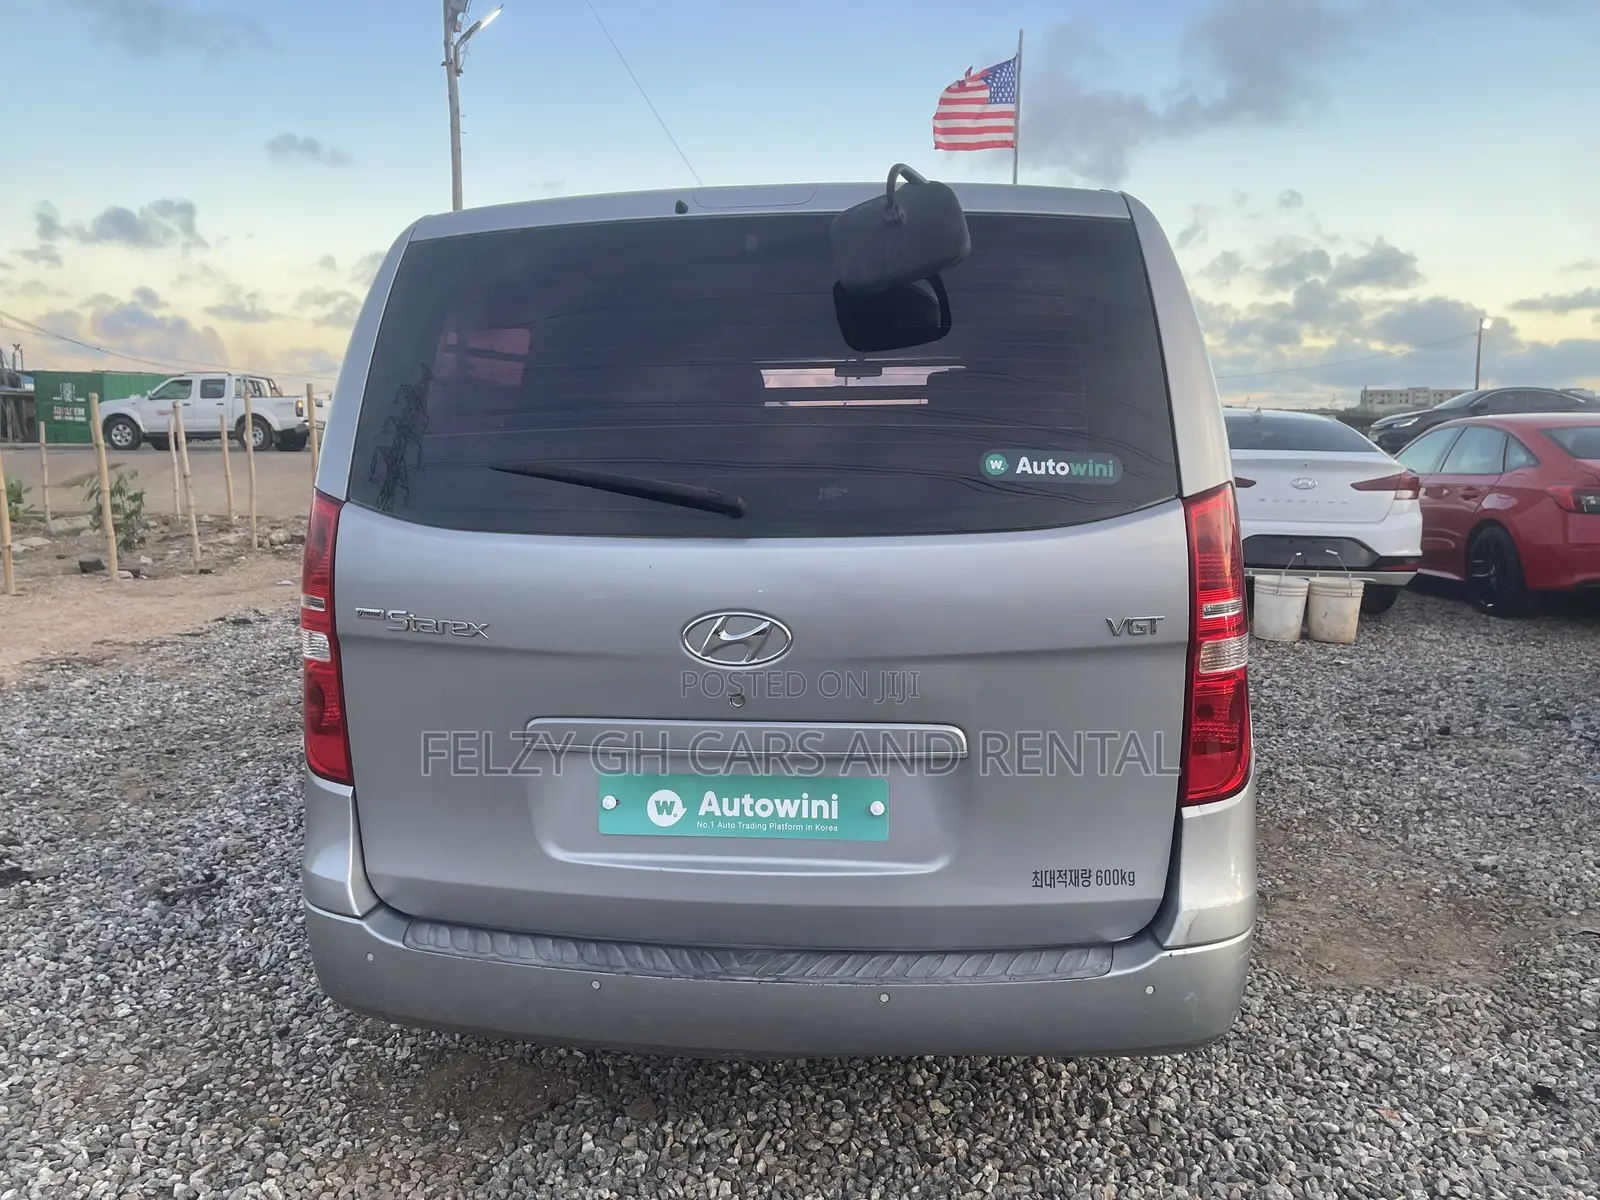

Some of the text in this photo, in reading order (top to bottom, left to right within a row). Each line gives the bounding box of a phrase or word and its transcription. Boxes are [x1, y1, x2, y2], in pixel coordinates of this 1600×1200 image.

[1015, 456, 1114, 478] Autowini
[386, 610, 489, 639] Starex
[1105, 615, 1166, 637] VGT
[698, 790, 839, 819] Autowini
[696, 821, 838, 832] No.1 Auto Trading Platform in Korea
[1032, 868, 1135, 888] 최대적재량 600kg
